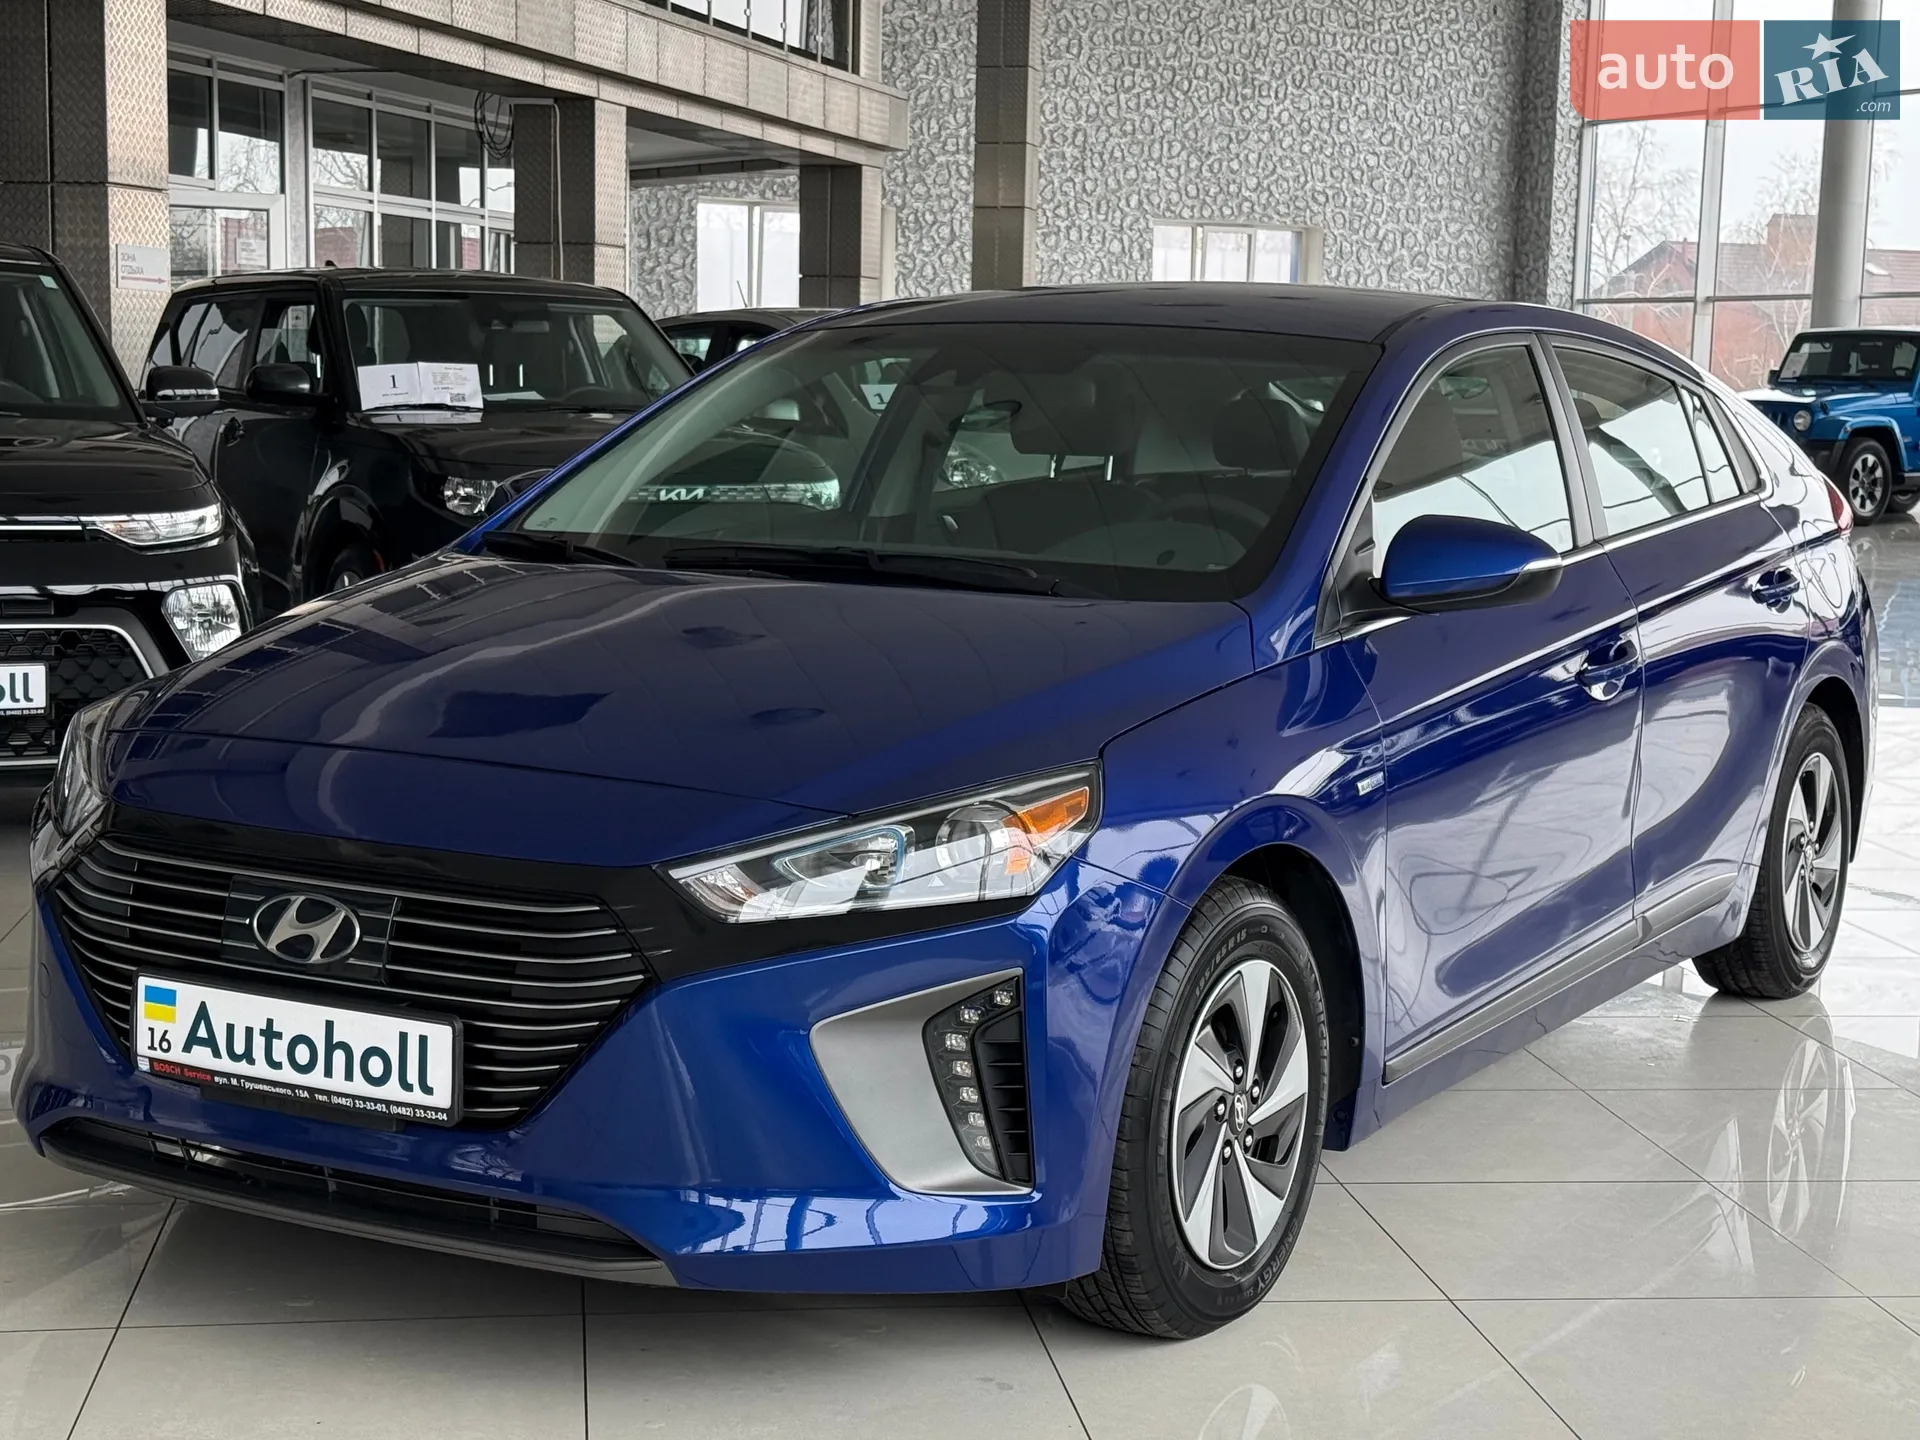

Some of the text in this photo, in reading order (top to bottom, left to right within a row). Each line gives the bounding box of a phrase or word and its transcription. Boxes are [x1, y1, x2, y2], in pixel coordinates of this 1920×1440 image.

[120, 252, 136, 262] ЗОНА
[120, 264, 144, 276] ОТДЫХА
[390, 374, 398, 389] 1
[147, 1001, 434, 1096] 16 Autoholl
[153, 1061, 181, 1076] BOSCH
[184, 1068, 212, 1082] Service
[331, 1095, 353, 1108] (0482)
[355, 1099, 389, 1114] 33-33-03,
[390, 1104, 414, 1118] (0482)
[415, 1109, 448, 1122] 33-33-04
